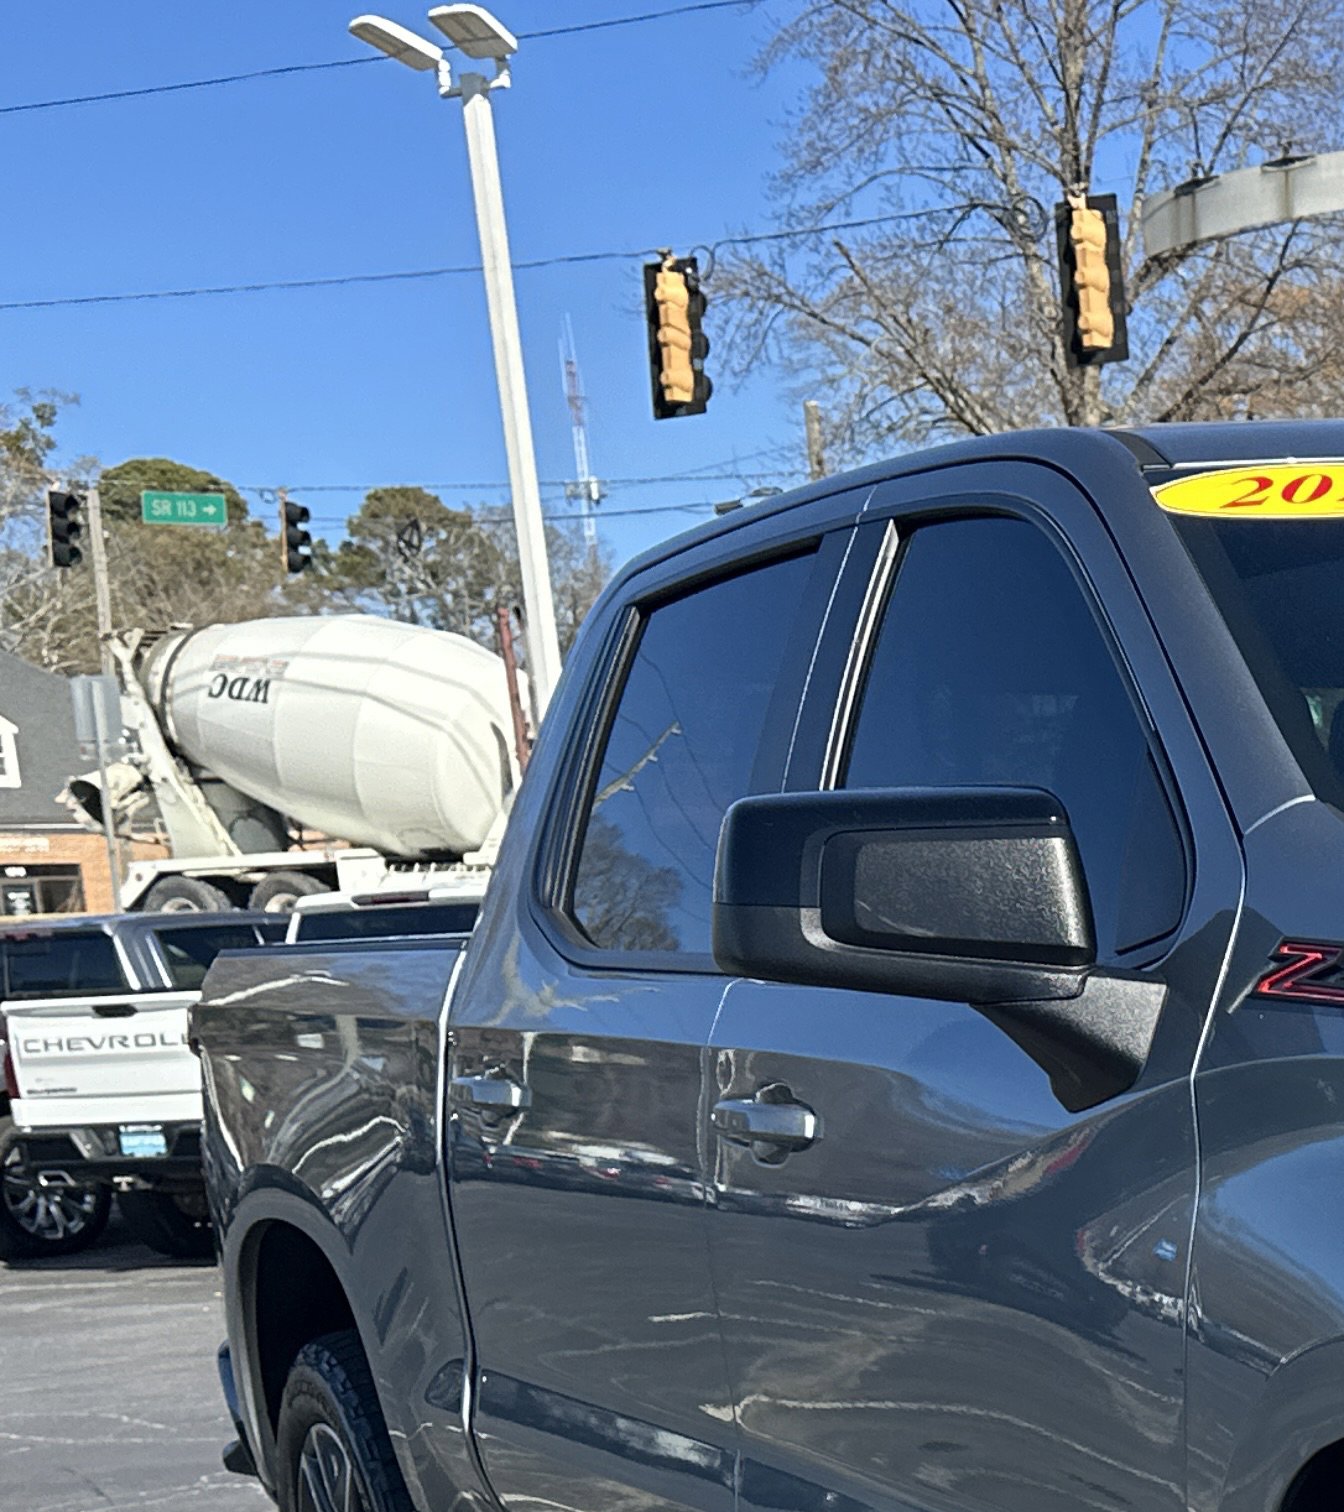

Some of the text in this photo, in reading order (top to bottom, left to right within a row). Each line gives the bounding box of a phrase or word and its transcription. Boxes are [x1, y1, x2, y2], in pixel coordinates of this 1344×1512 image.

[151, 499, 197, 518] SR 113
[207, 673, 271, 704] WDC
